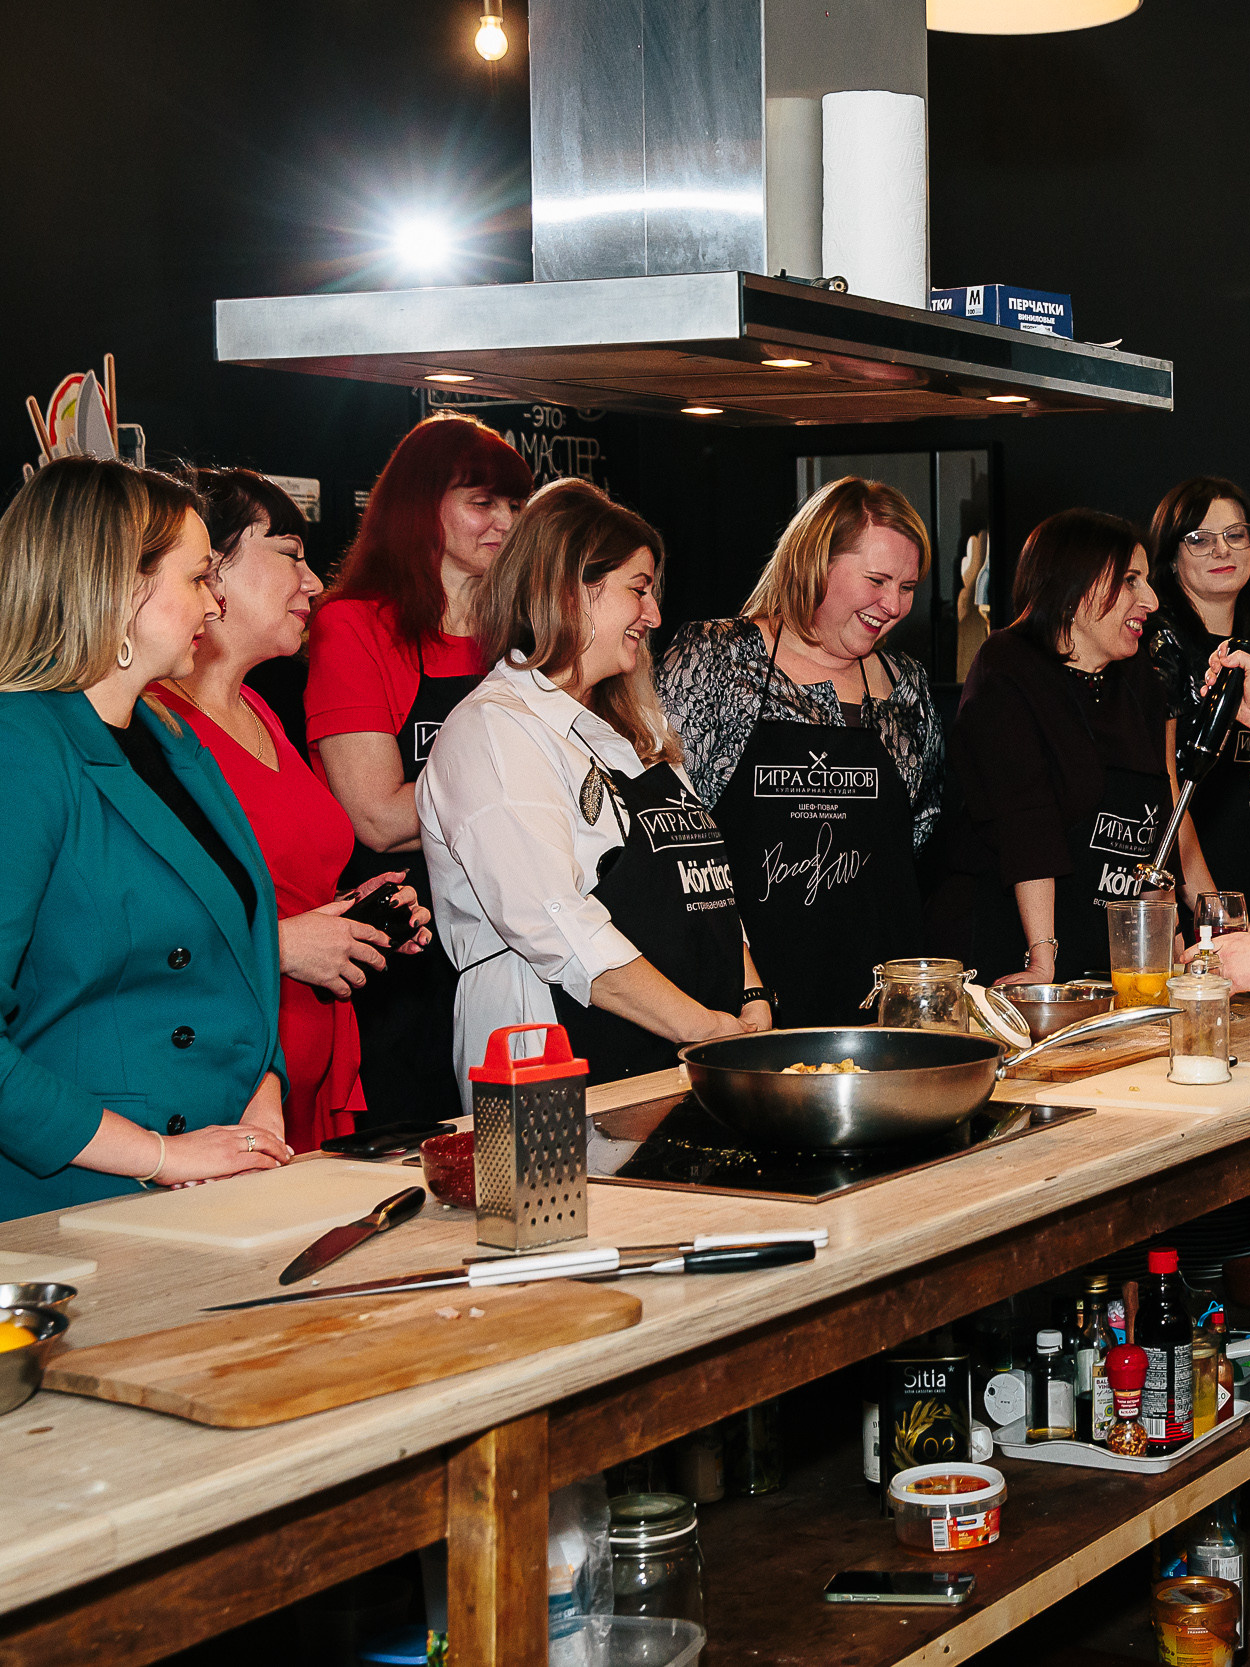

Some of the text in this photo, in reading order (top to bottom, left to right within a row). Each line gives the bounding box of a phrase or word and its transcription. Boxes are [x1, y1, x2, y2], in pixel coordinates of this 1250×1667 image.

[1008, 297, 1064, 316] ПЕРЧАТКИ
[1018, 313, 1055, 325] ВИНИЛОВЫЕ
[759, 769, 874, 788] ИГРА СТОЛОВ
[798, 803, 839, 811] ШЕФ-ПОВАР
[819, 812, 847, 820] МИХАИЛ
[643, 812, 691, 834] ИГРА
[1098, 818, 1133, 843] ИГРА
[904, 1366, 946, 1388] Sitia
